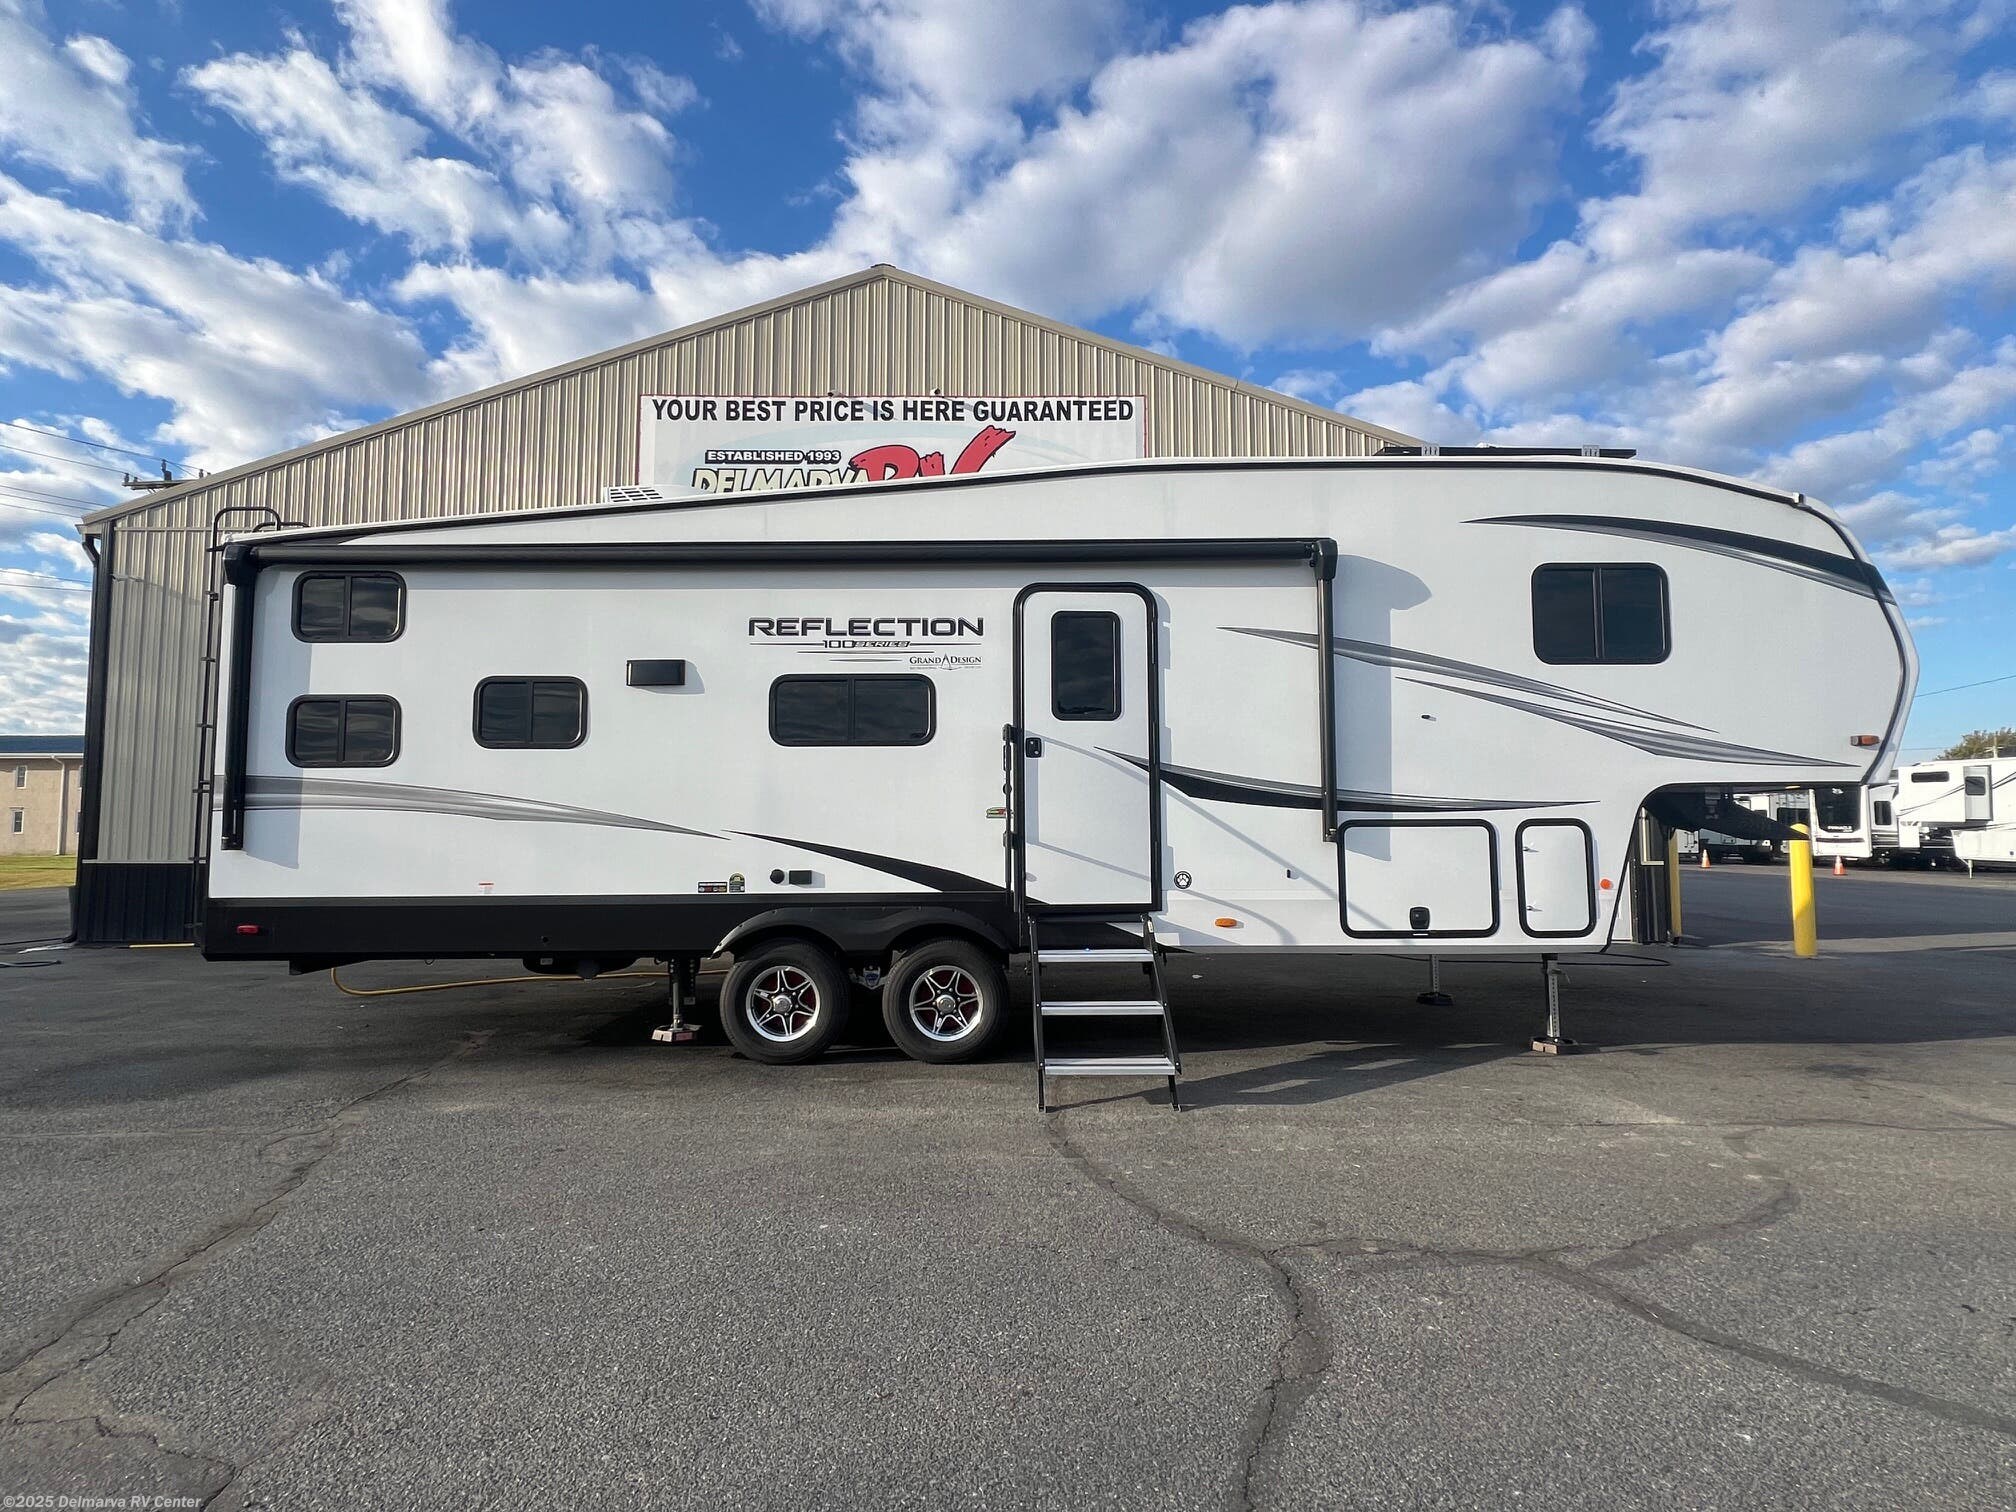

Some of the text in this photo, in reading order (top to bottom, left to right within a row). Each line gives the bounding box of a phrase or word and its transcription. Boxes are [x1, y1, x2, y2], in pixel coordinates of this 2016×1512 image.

[652, 399, 1133, 421] YOUR BEST PRICE IS HERE GUARANTEED
[707, 450, 840, 462] ESTABLISHED 1993
[748, 617, 984, 637] REFLECTION
[909, 655, 982, 665] GRAND DESIGN
